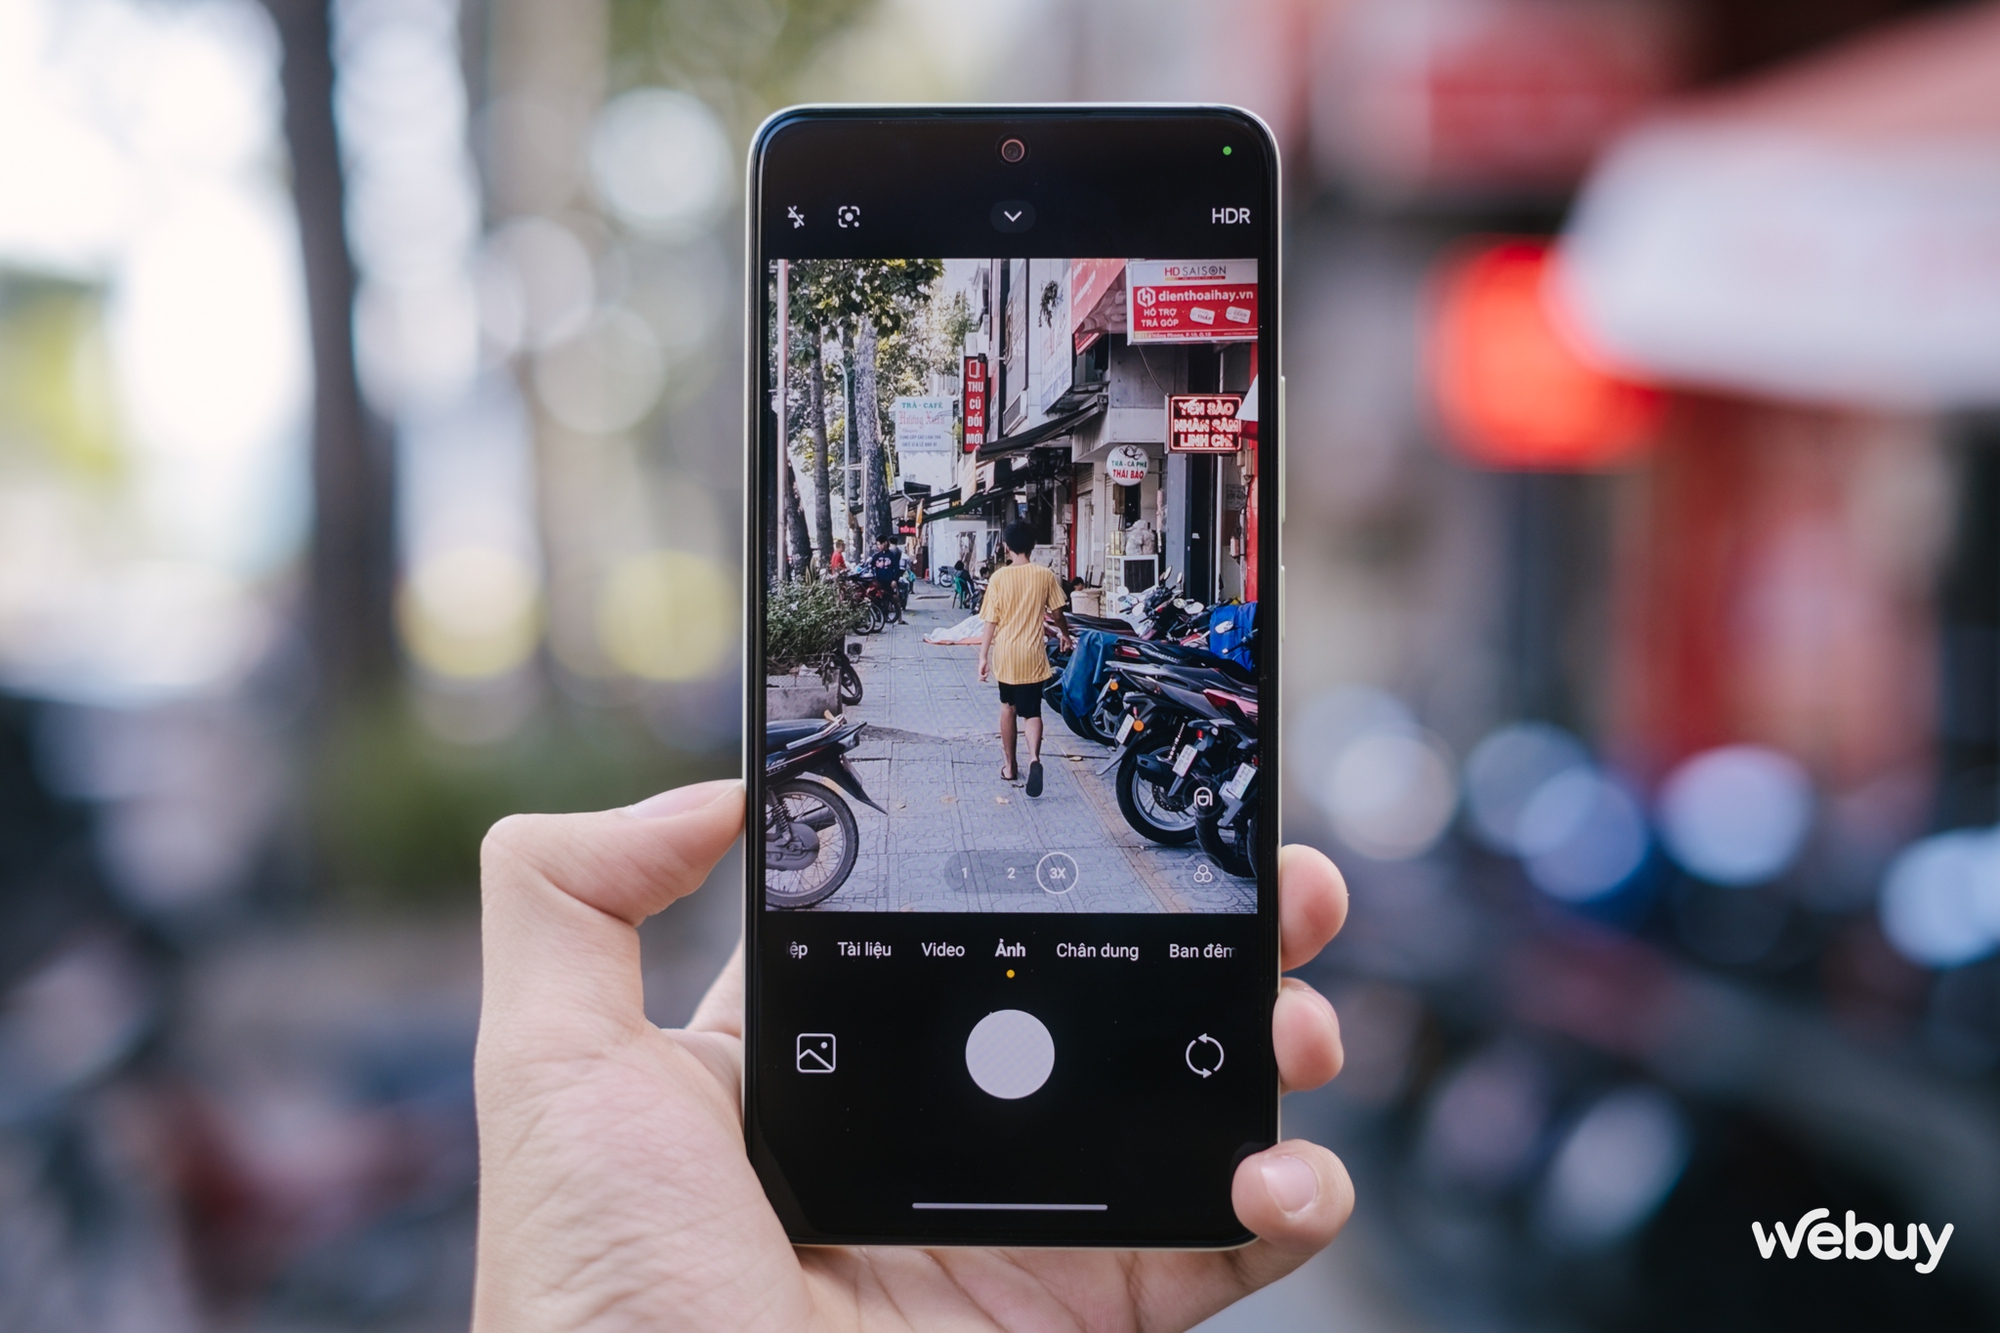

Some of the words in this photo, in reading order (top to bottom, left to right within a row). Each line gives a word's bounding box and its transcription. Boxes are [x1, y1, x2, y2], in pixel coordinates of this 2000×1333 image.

[1212, 207, 1251, 224] HDR
[1164, 266, 1180, 277] HD
[1182, 265, 1227, 276] SAISON
[1158, 289, 1254, 303] dienthoaihay.vn
[967, 381, 984, 393] THU
[961, 867, 968, 879] 1
[1007, 867, 1015, 879] 2
[1049, 867, 1066, 879] 3X
[837, 941, 861, 957] Tài
[864, 941, 892, 959] liệu
[921, 942, 966, 957] Video
[994, 938, 1026, 957] Ảnh
[1056, 942, 1096, 958] Chân
[1100, 943, 1140, 961] dung
[1169, 944, 1199, 958] Ban
